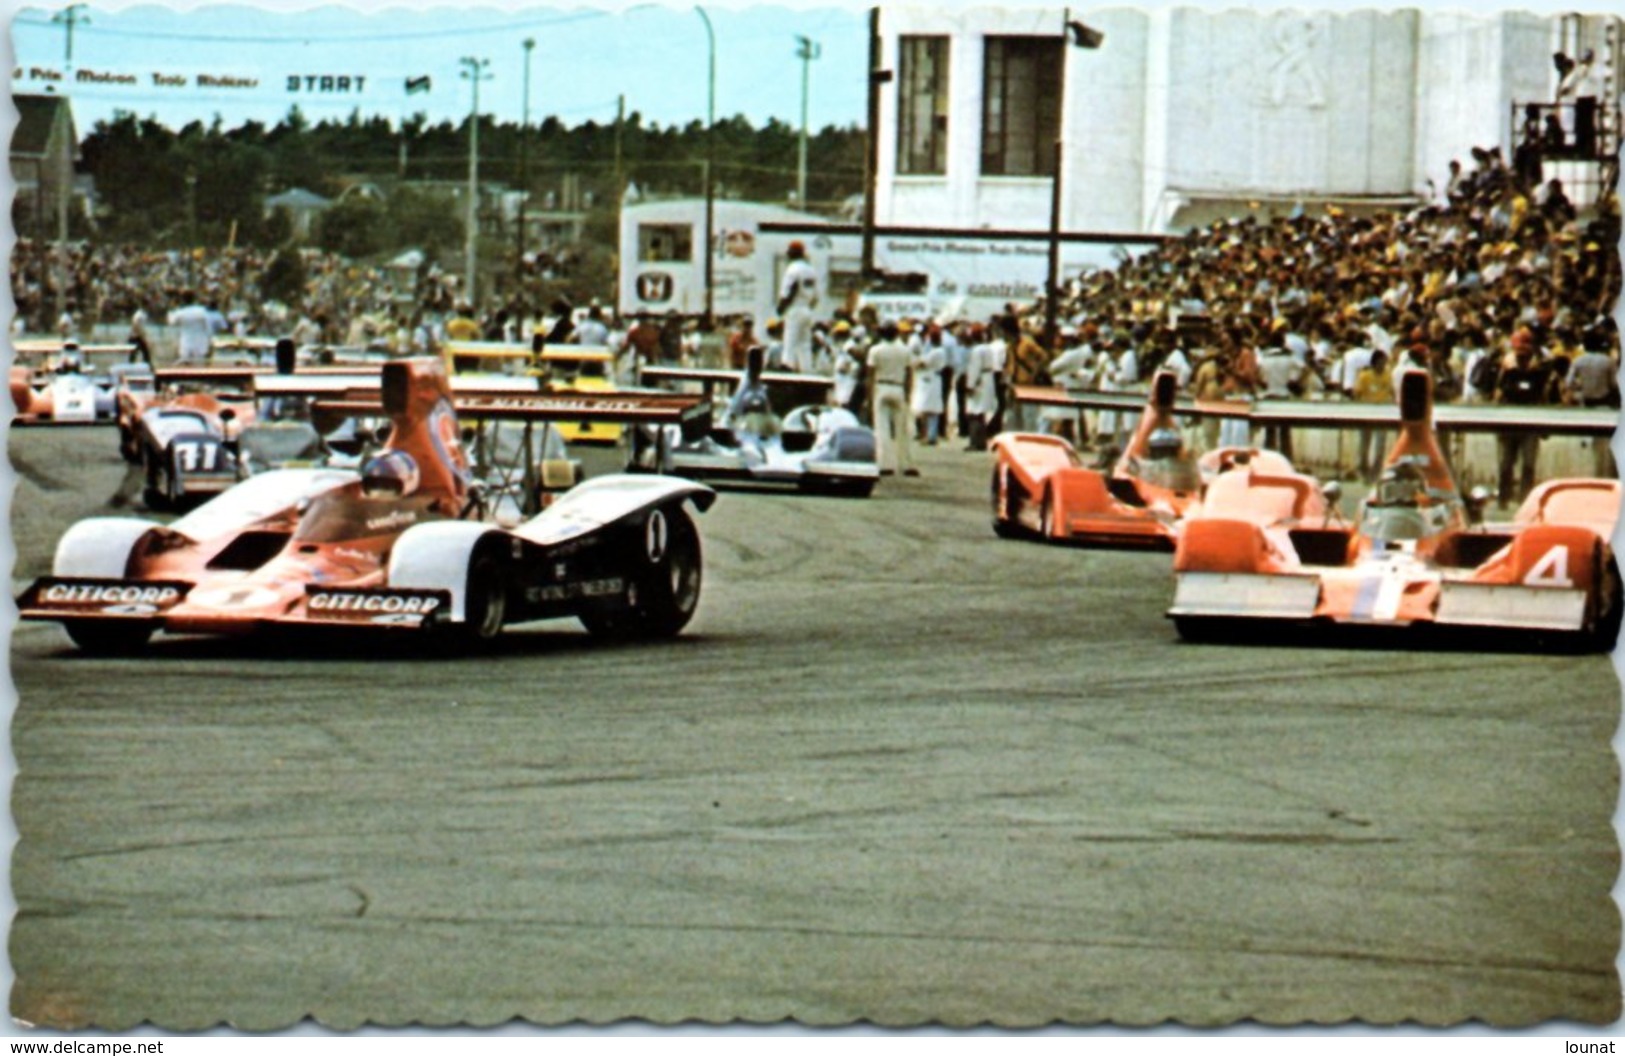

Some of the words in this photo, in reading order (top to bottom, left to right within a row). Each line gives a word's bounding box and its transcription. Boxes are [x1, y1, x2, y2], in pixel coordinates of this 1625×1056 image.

[30, 67, 62, 81] Prix
[152, 72, 187, 86] Trois
[287, 75, 366, 92] START
[1523, 545, 1574, 587] 4
[46, 584, 178, 603] CITICORP
[308, 593, 440, 613] CITICORP
